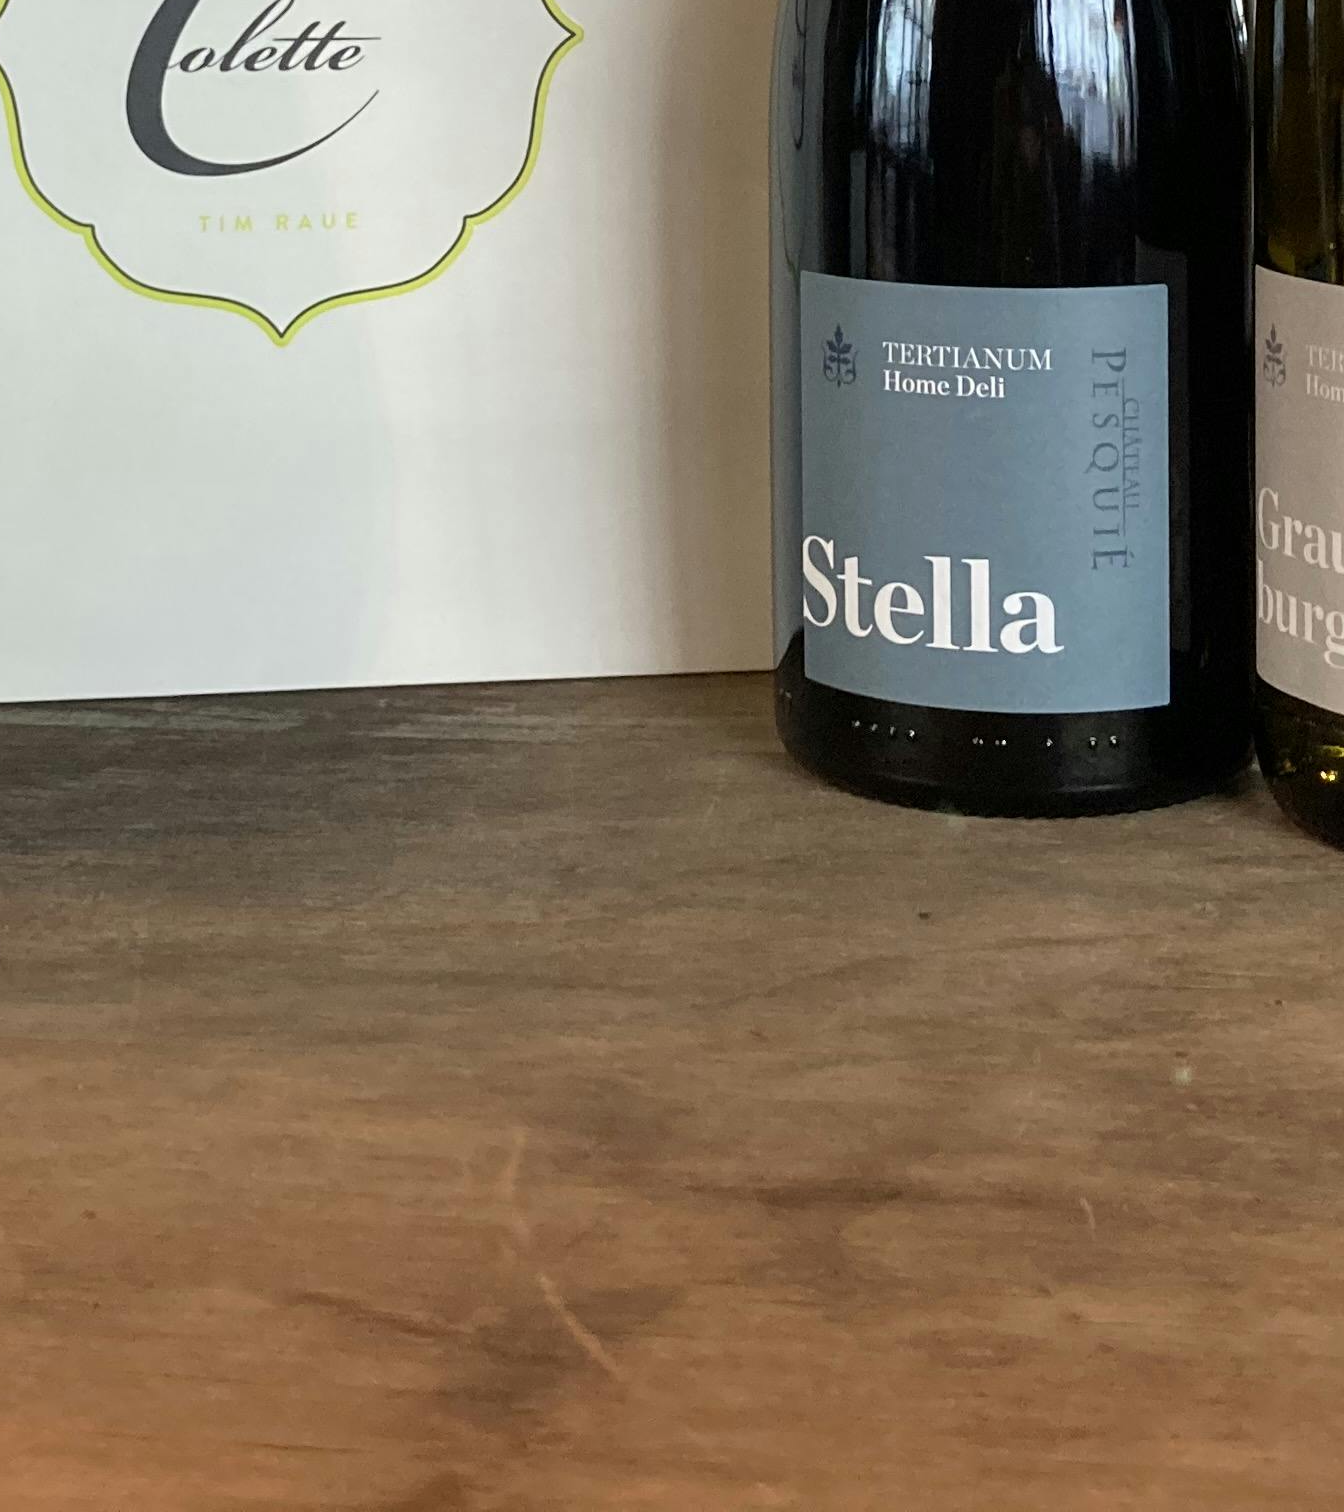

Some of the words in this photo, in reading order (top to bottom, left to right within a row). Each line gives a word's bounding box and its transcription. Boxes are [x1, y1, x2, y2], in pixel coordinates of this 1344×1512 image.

[199, 214, 254, 234] TIM
[275, 211, 361, 232] RAUE
[882, 340, 1054, 372] TERTIANUM
[883, 370, 951, 397] Home
[955, 375, 1006, 400] Deli
[802, 534, 1065, 655] Stella
